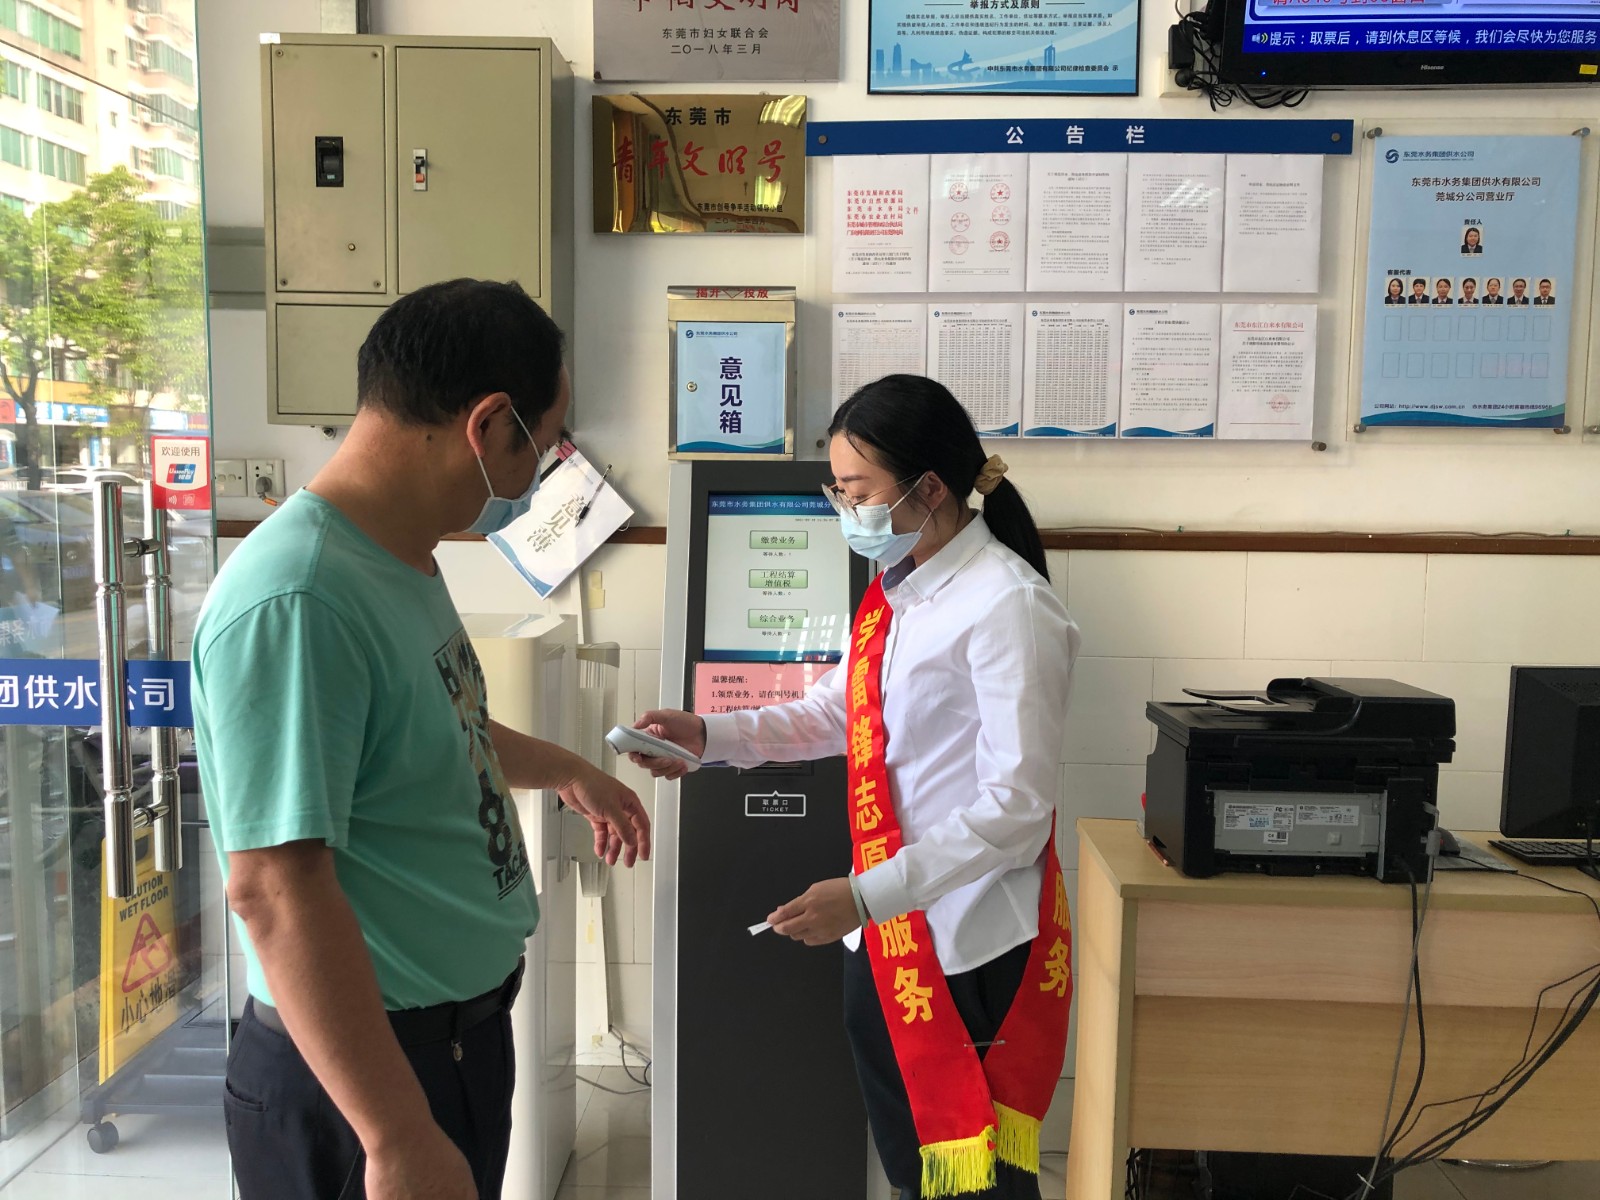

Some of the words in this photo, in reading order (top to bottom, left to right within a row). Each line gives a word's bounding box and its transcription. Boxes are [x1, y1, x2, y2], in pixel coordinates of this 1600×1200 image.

[662, 28, 769, 39] 东莞市妇女联合会
[665, 107, 732, 126] 东莞市
[1005, 125, 1146, 145] 公告栏
[1403, 150, 1475, 158] 东莞水务集团供水公司
[612, 136, 787, 184] 青年文明号
[1411, 177, 1541, 188] 东莞市水务集团供水有限公司
[1435, 191, 1515, 202] 莞城分公司营业厅
[696, 287, 721, 299] 揭开
[744, 287, 769, 299] 投放
[719, 356, 743, 434] 意见箱
[161, 446, 201, 457] 欢迎使用
[526, 493, 593, 553] 意见簿
[760, 536, 796, 545] 缴费业务
[760, 571, 796, 579] 工程结算
[765, 579, 792, 587] 增值税
[759, 614, 795, 623] 综合业务
[119, 902, 138, 922] WET
[141, 886, 169, 911] FLOOR
